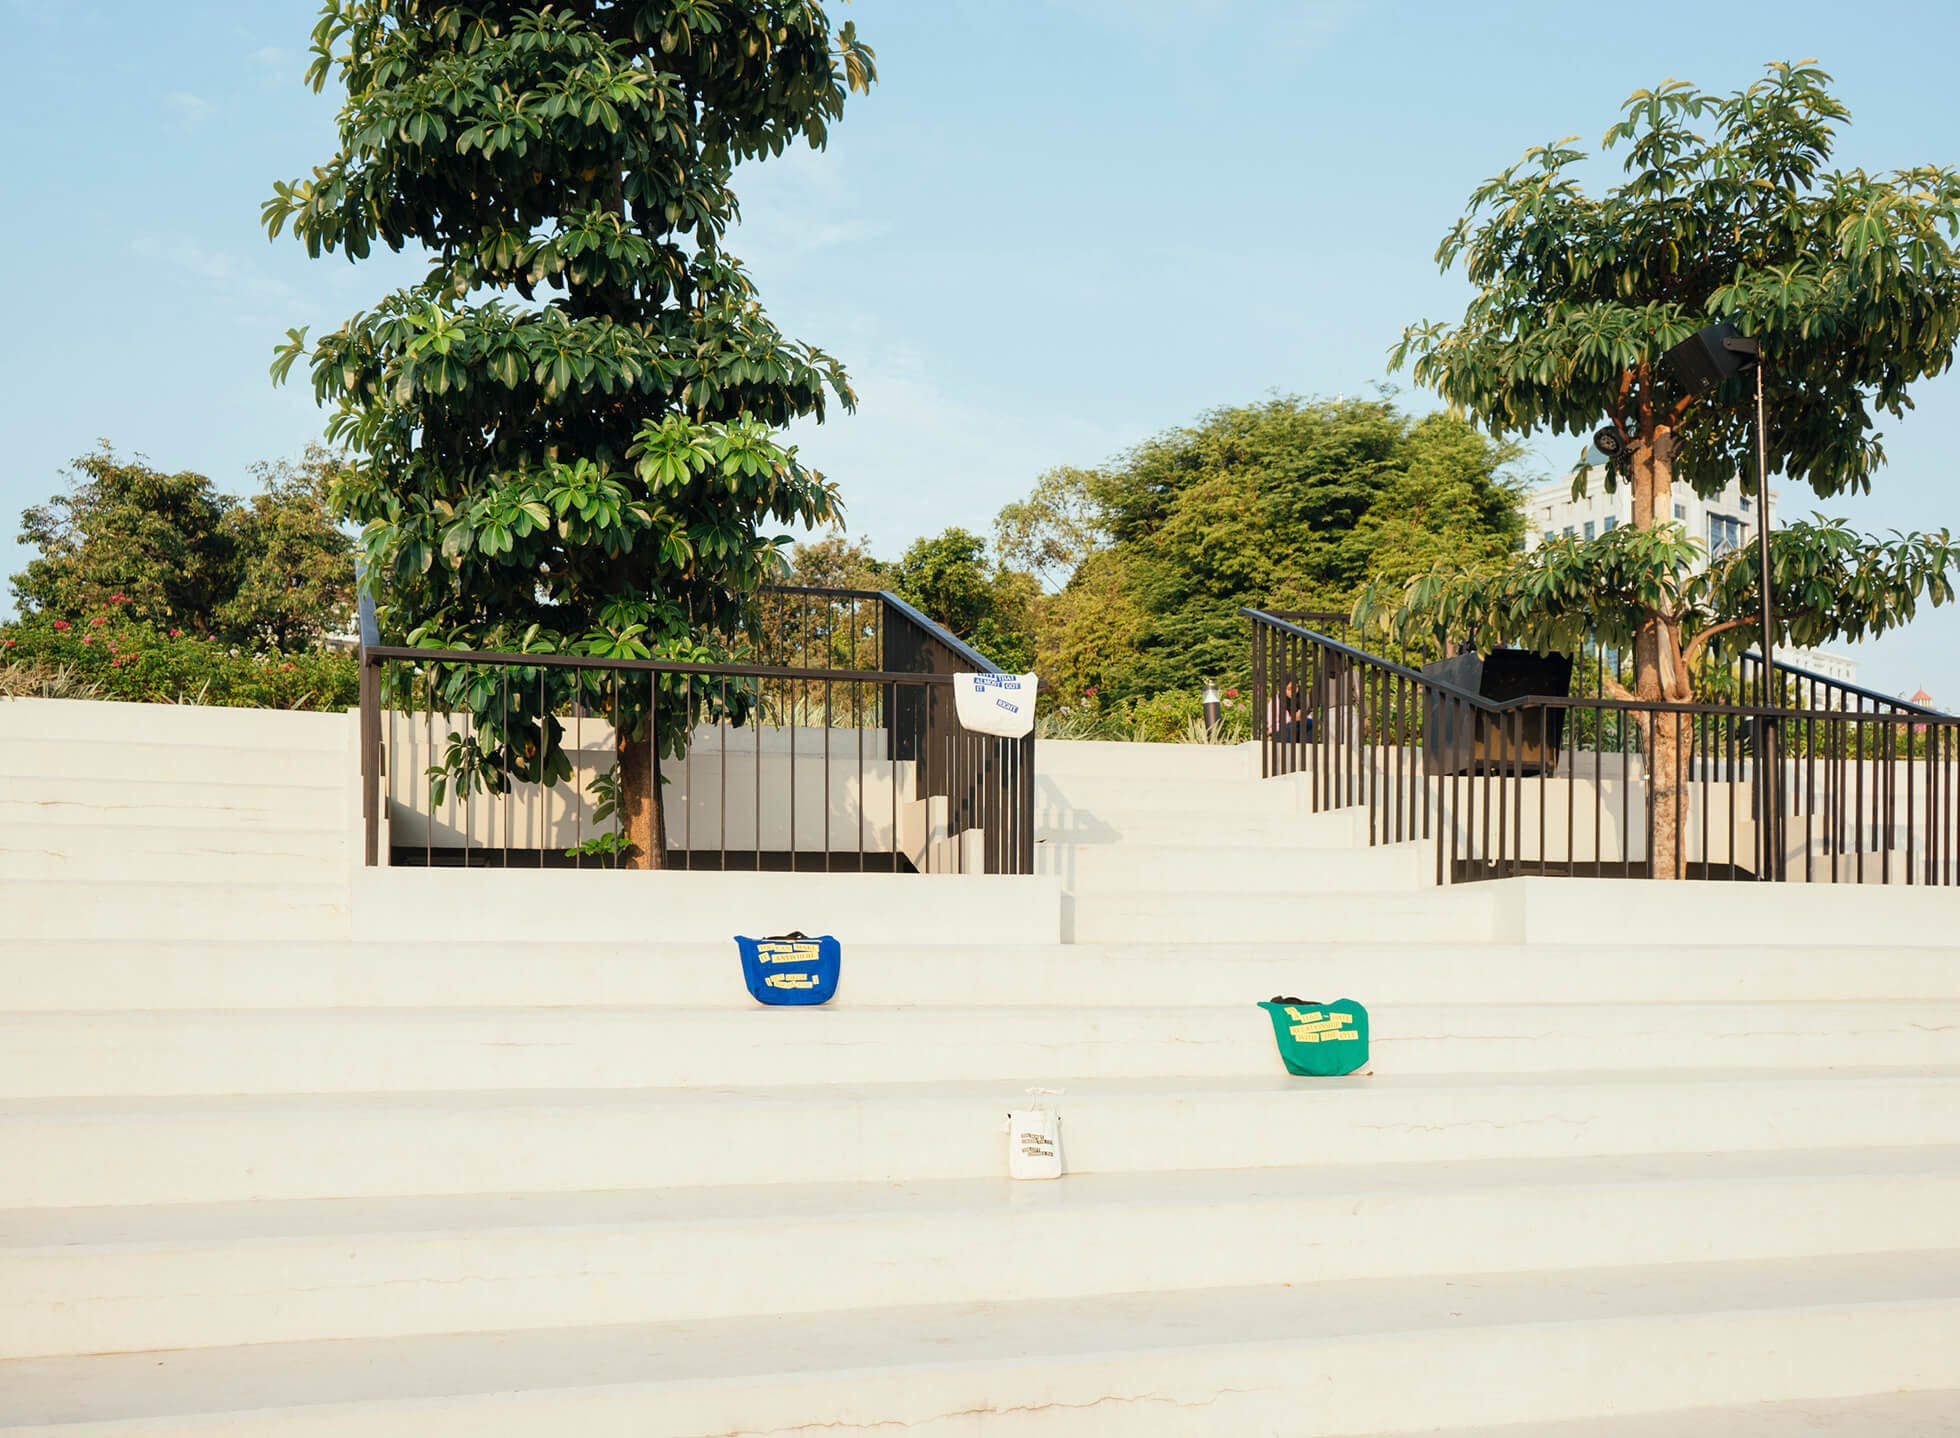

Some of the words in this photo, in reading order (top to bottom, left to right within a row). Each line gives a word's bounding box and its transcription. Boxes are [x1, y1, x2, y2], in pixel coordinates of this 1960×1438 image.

[975, 677, 1001, 687] ALMOST
[997, 699, 1018, 713] RIGHT
[772, 952, 818, 962] ANYWHERE
